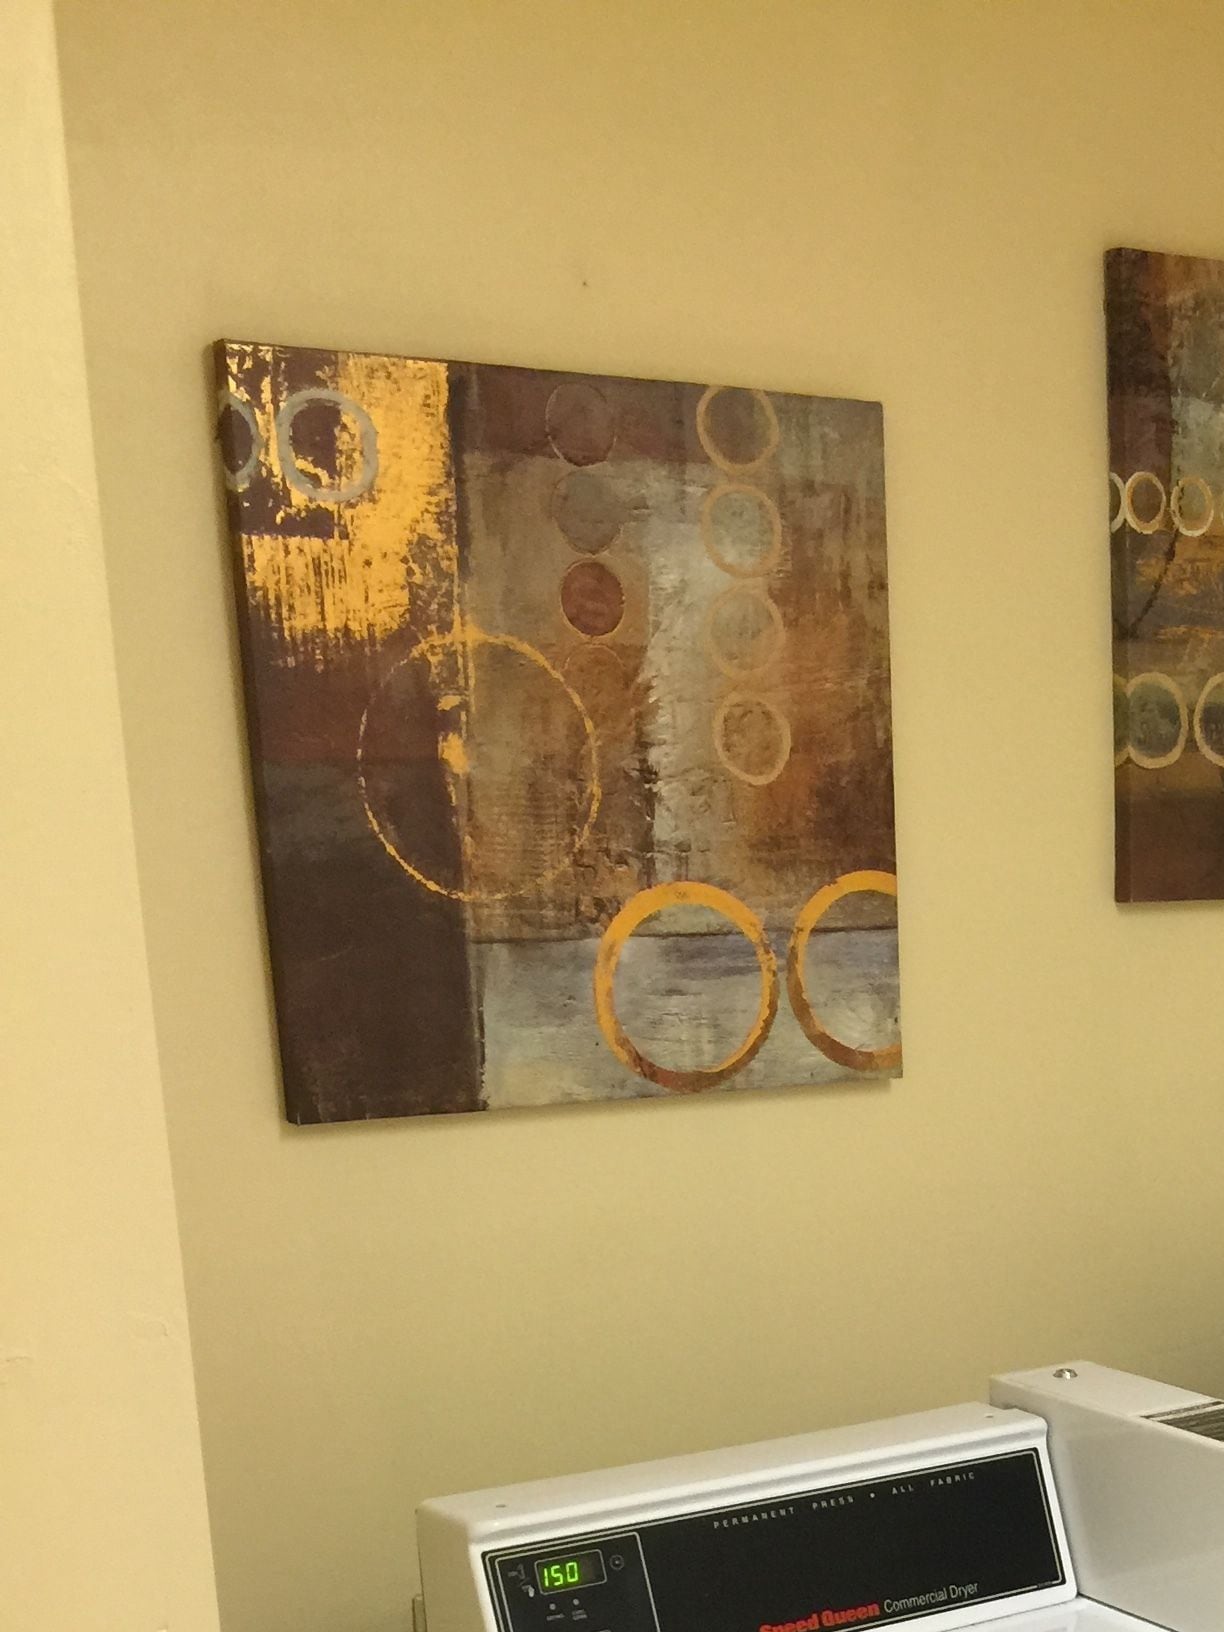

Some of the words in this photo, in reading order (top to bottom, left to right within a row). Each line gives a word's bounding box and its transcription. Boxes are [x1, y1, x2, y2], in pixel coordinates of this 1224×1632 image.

[713, 1507, 794, 1529] PERMANENT
[812, 1495, 854, 1511] PRESS
[892, 1484, 914, 1495] ALL
[930, 1472, 975, 1487] FABRIC
[543, 1561, 579, 1588] 150
[821, 1602, 880, 1628] Queen
[884, 1587, 947, 1614] Commercial
[949, 1582, 978, 1601] Dryer
